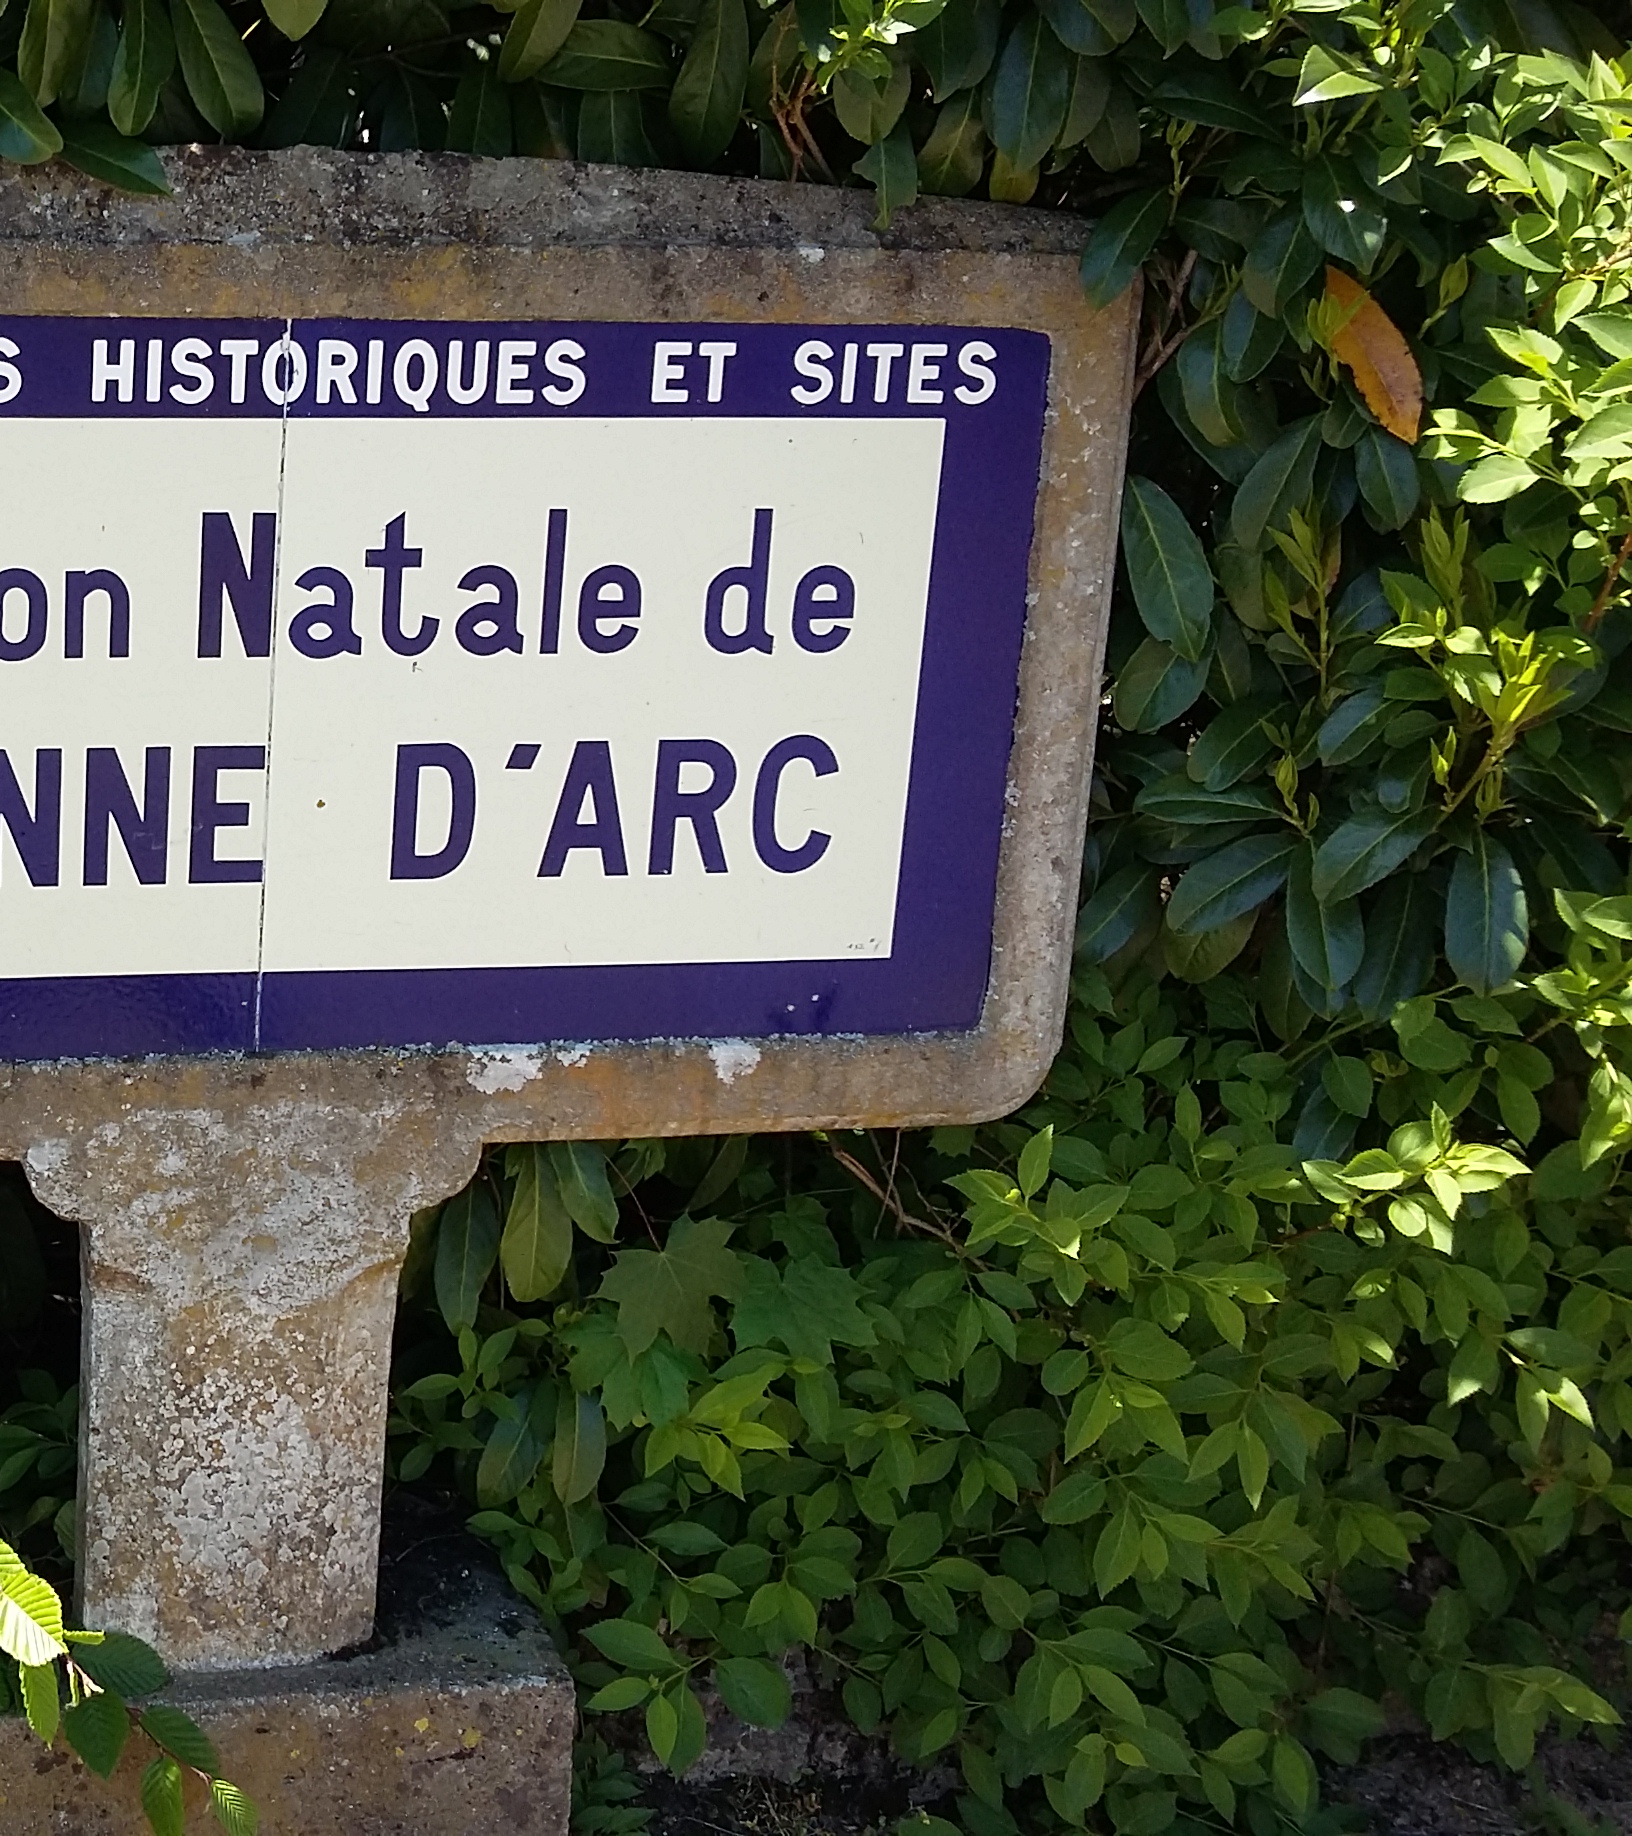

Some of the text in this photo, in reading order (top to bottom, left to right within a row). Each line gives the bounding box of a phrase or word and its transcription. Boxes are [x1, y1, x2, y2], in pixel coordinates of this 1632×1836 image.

[90, 336, 587, 413] HISTORIQUES
[650, 340, 738, 405] ET
[789, 340, 999, 407] SITES
[196, 507, 643, 661] Natale
[703, 507, 857, 656] de
[388, 733, 841, 882] D'ARC
